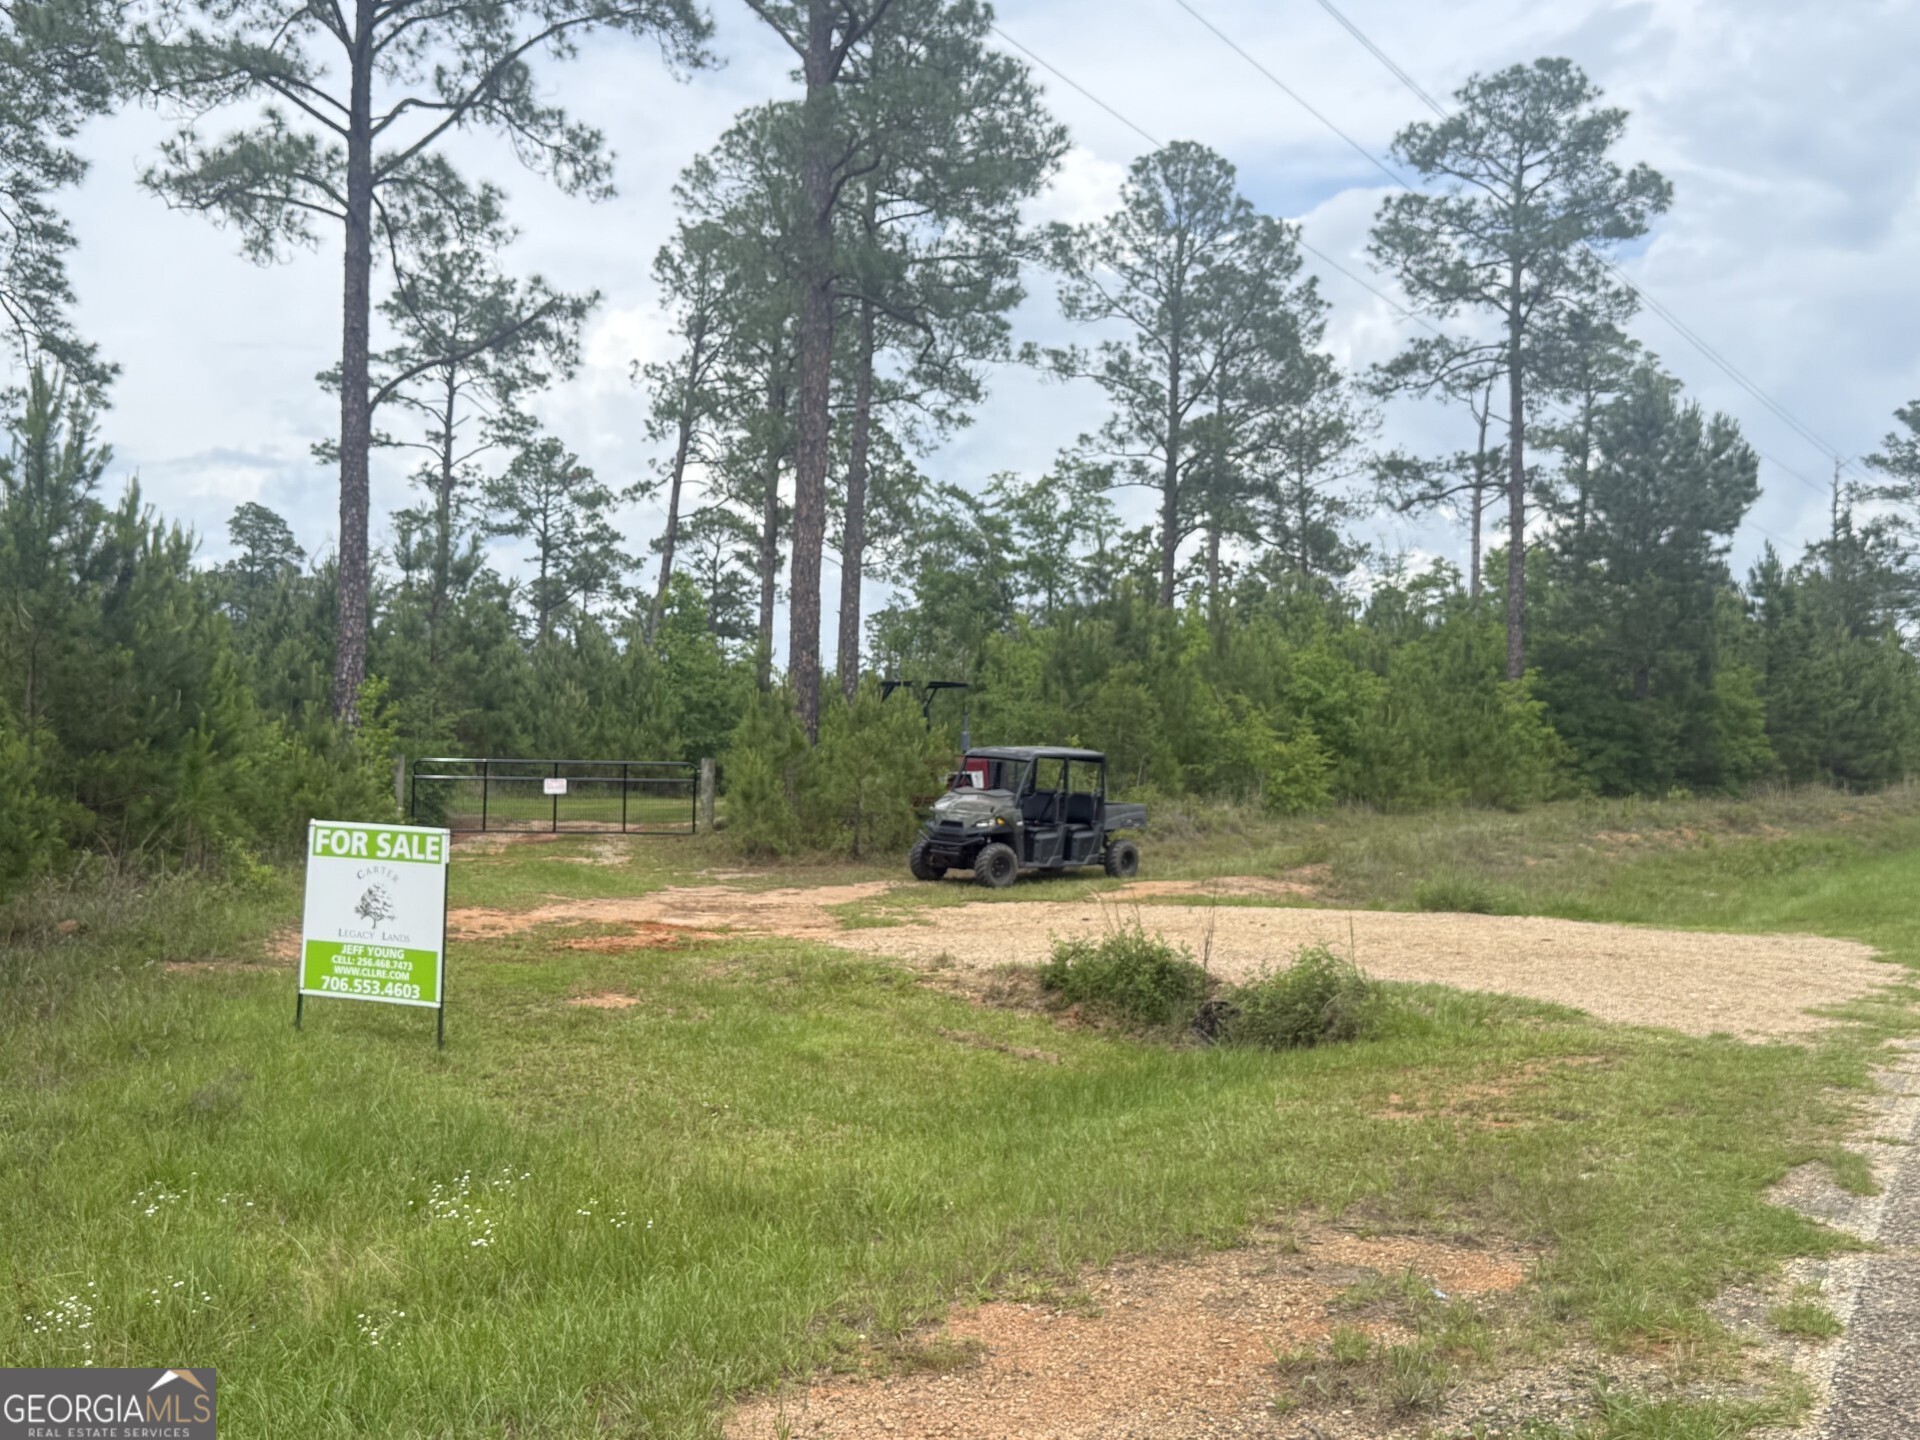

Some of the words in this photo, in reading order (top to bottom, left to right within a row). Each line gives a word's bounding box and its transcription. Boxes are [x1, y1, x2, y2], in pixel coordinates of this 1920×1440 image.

[315, 828, 369, 856] FOR
[375, 832, 440, 861] SALE
[356, 865, 400, 883] CARTER
[338, 928, 375, 939] LEGACY
[381, 931, 411, 942] LANDS
[341, 944, 365, 955] JEFF
[367, 947, 405, 959] YOUNG
[331, 954, 355, 965] CELL:
[356, 957, 413, 971] 256.468.7473
[333, 965, 410, 981] WWW.CLLRE.COM
[320, 975, 421, 999] 706.553.4603
